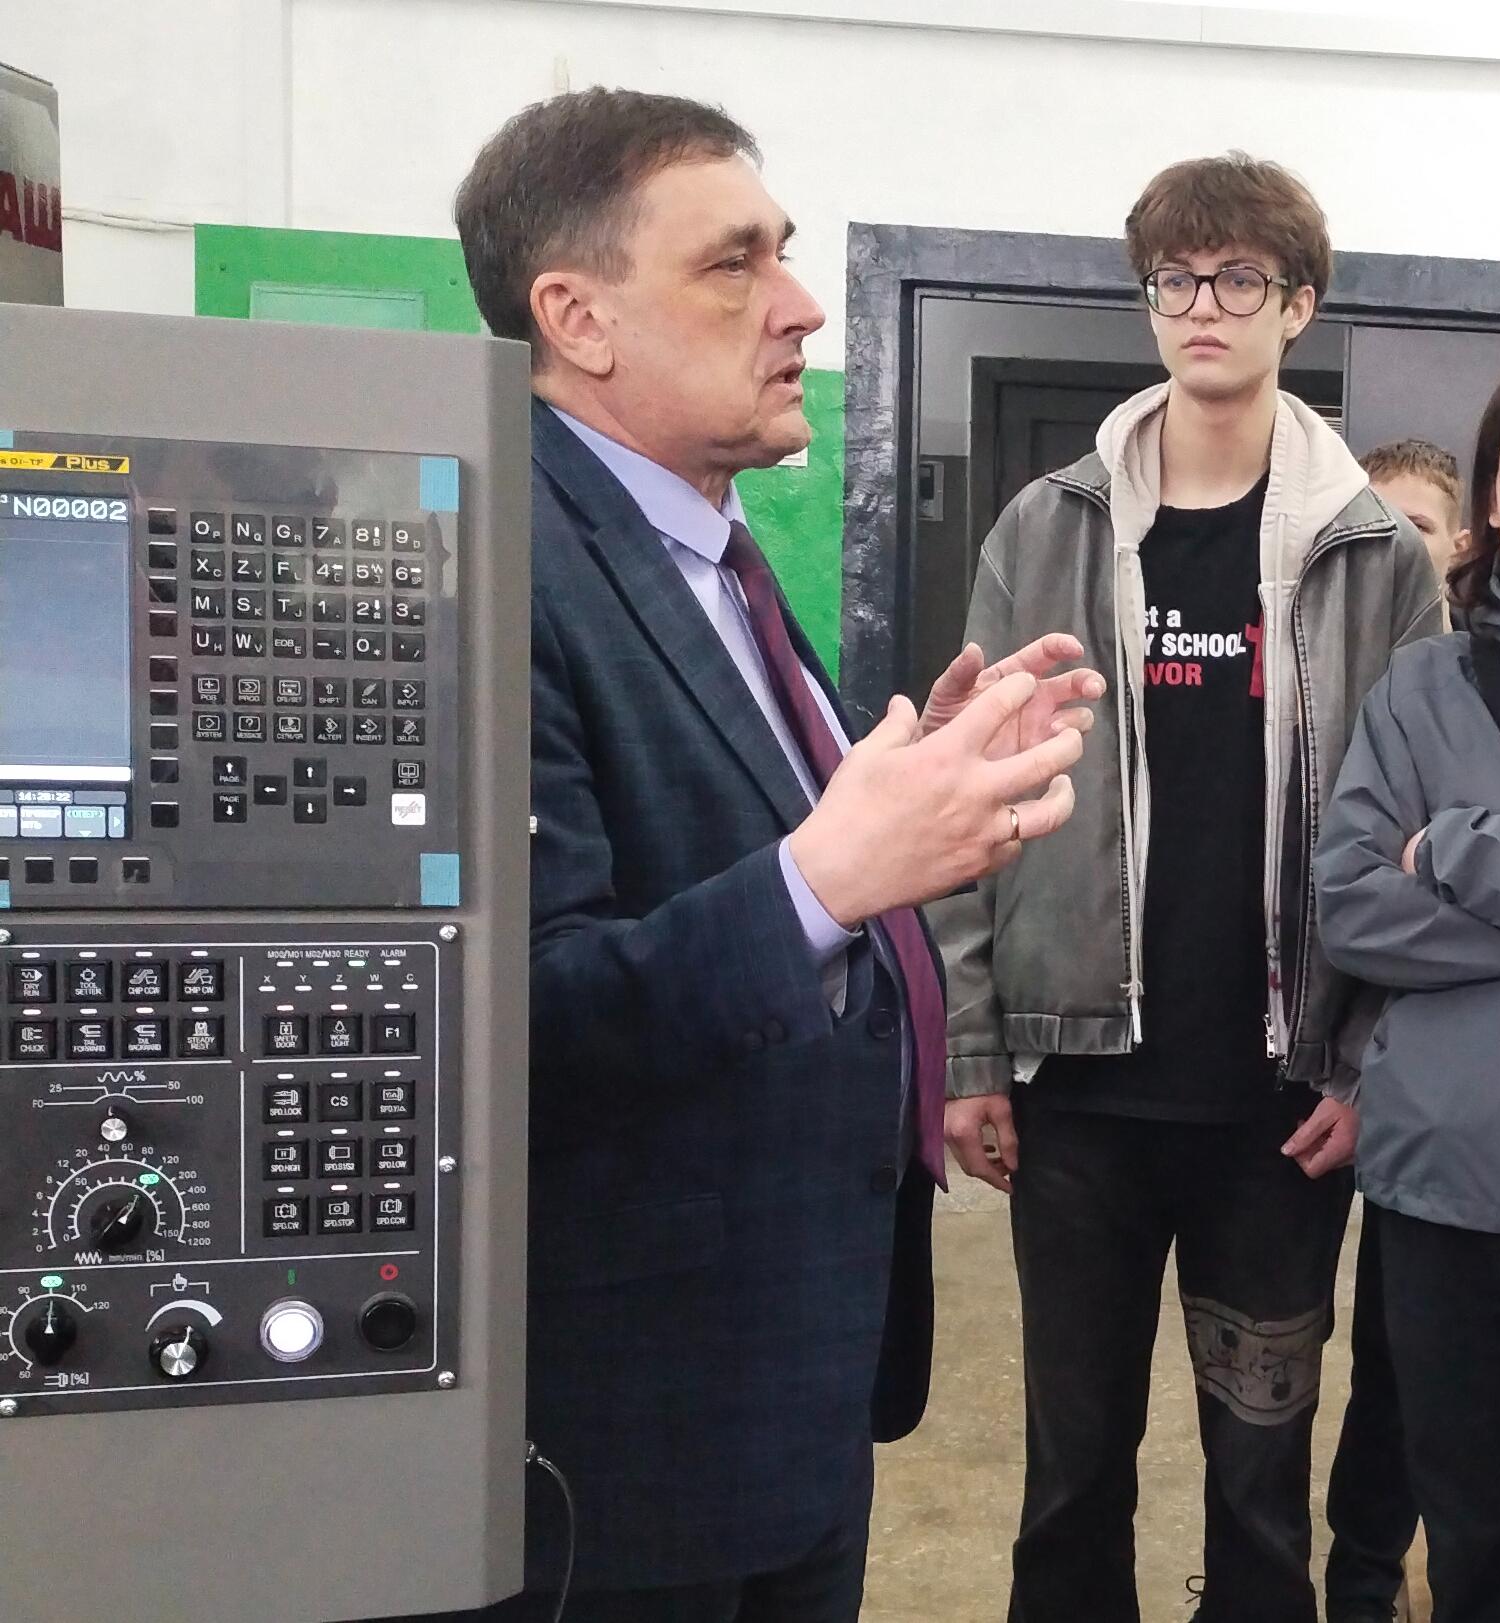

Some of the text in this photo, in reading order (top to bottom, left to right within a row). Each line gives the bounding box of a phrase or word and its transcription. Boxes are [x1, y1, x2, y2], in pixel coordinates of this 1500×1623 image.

[66, 456, 110, 470] Plus
[13, 496, 127, 520] N00002
[237, 522, 250, 537] N
[276, 525, 290, 538] G
[315, 526, 328, 540] 7
[356, 528, 369, 542] 8
[395, 530, 408, 543] 9
[197, 559, 209, 573] X
[237, 560, 249, 574] Z
[277, 562, 289, 575] F
[316, 564, 330, 577] 4
[356, 565, 369, 578] 5
[395, 567, 408, 580] 6
[195, 596, 209, 610] M
[237, 598, 250, 612] S
[278, 599, 290, 612] T
[318, 601, 325, 614] 1
[357, 602, 369, 615] 2
[396, 603, 408, 617] 3
[1167, 609, 1181, 627] a
[196, 633, 209, 647] U
[236, 634, 251, 649] W
[275, 639, 294, 647] EOB
[1145, 632, 1246, 657] Y SCHOOL
[1145, 663, 1203, 686] VOR
[380, 949, 407, 957] ALARM
[264, 975, 270, 983] X
[385, 1027, 400, 1038] F1
[49, 1084, 62, 1093] 25
[167, 1081, 180, 1090] 50
[186, 1095, 203, 1104] 100
[330, 1096, 348, 1106] CS
[75, 1149, 88, 1157] 20
[121, 1143, 133, 1151] 60
[162, 1156, 179, 1164] 120
[179, 1171, 197, 1179] 200
[75, 1178, 87, 1186] 50
[192, 1203, 210, 1211] 600
[163, 1229, 178, 1237] 150
[187, 1238, 211, 1246] 1200
[18, 1286, 30, 1294] 90
